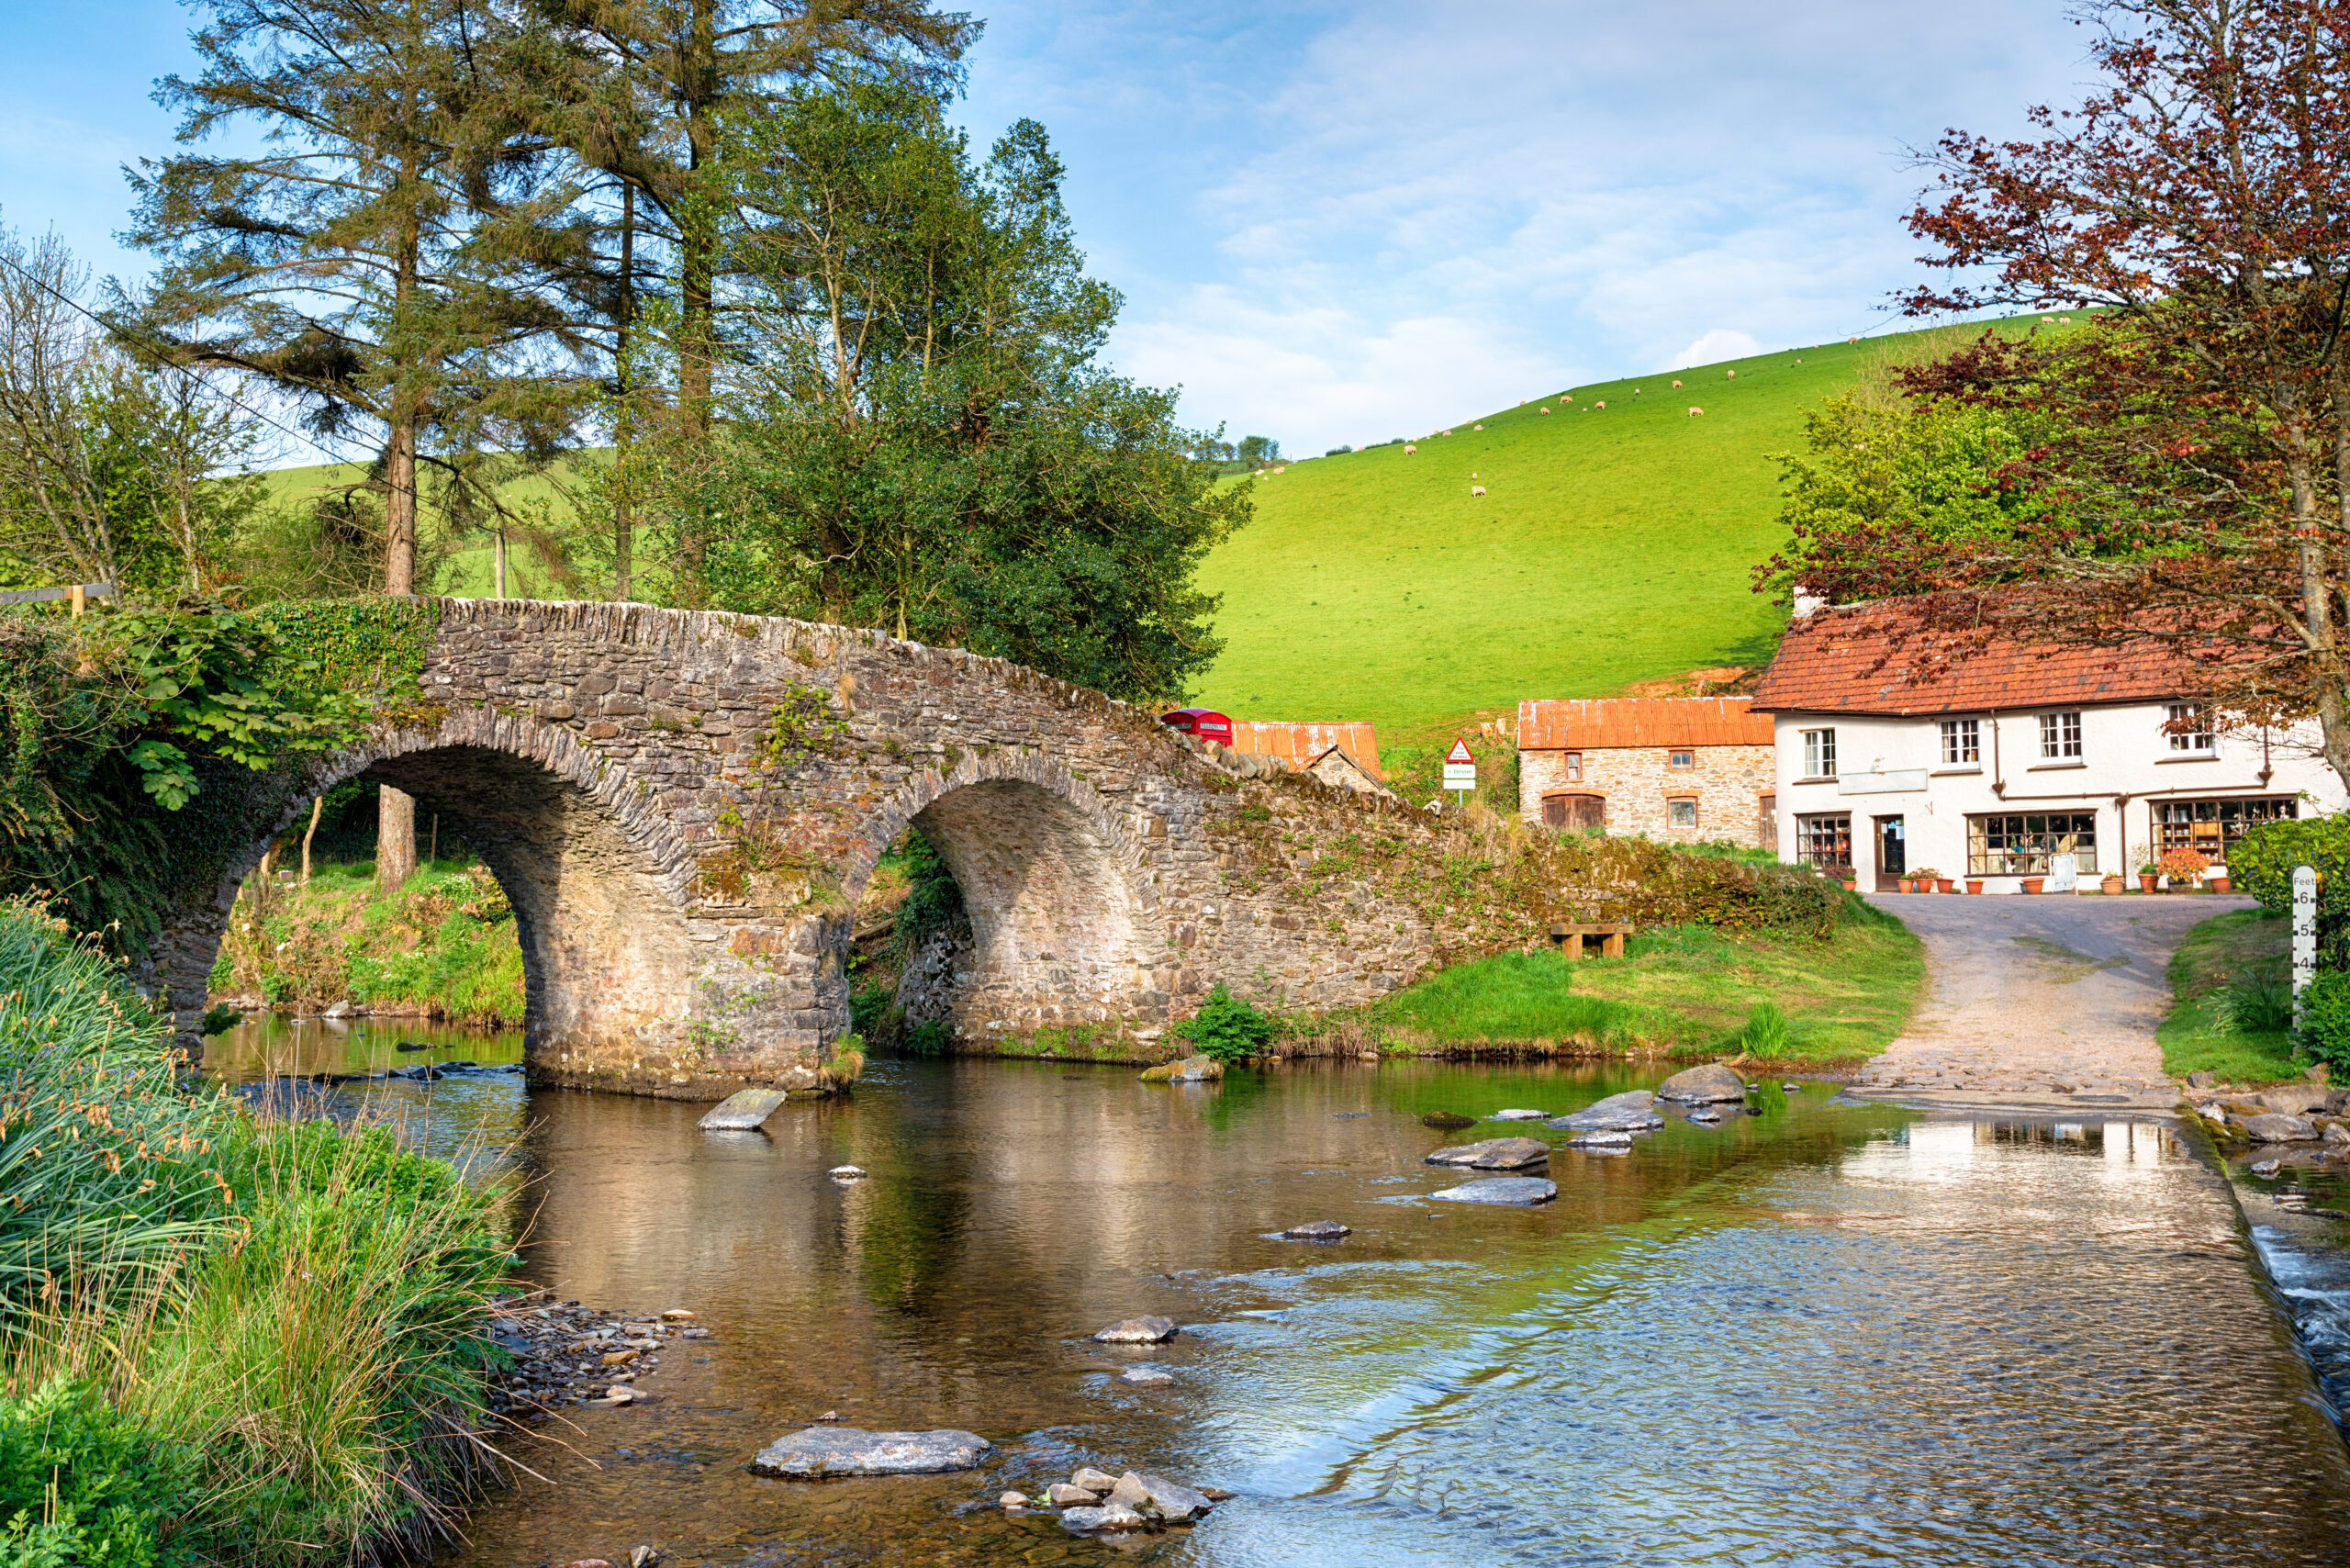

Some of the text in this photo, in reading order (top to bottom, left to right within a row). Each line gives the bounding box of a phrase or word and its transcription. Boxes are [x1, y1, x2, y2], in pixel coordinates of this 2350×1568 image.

[2294, 877, 2315, 886] Feet
[2300, 891, 2309, 904] 6
[2300, 924, 2310, 936] 5
[2300, 957, 2310, 969] 4
